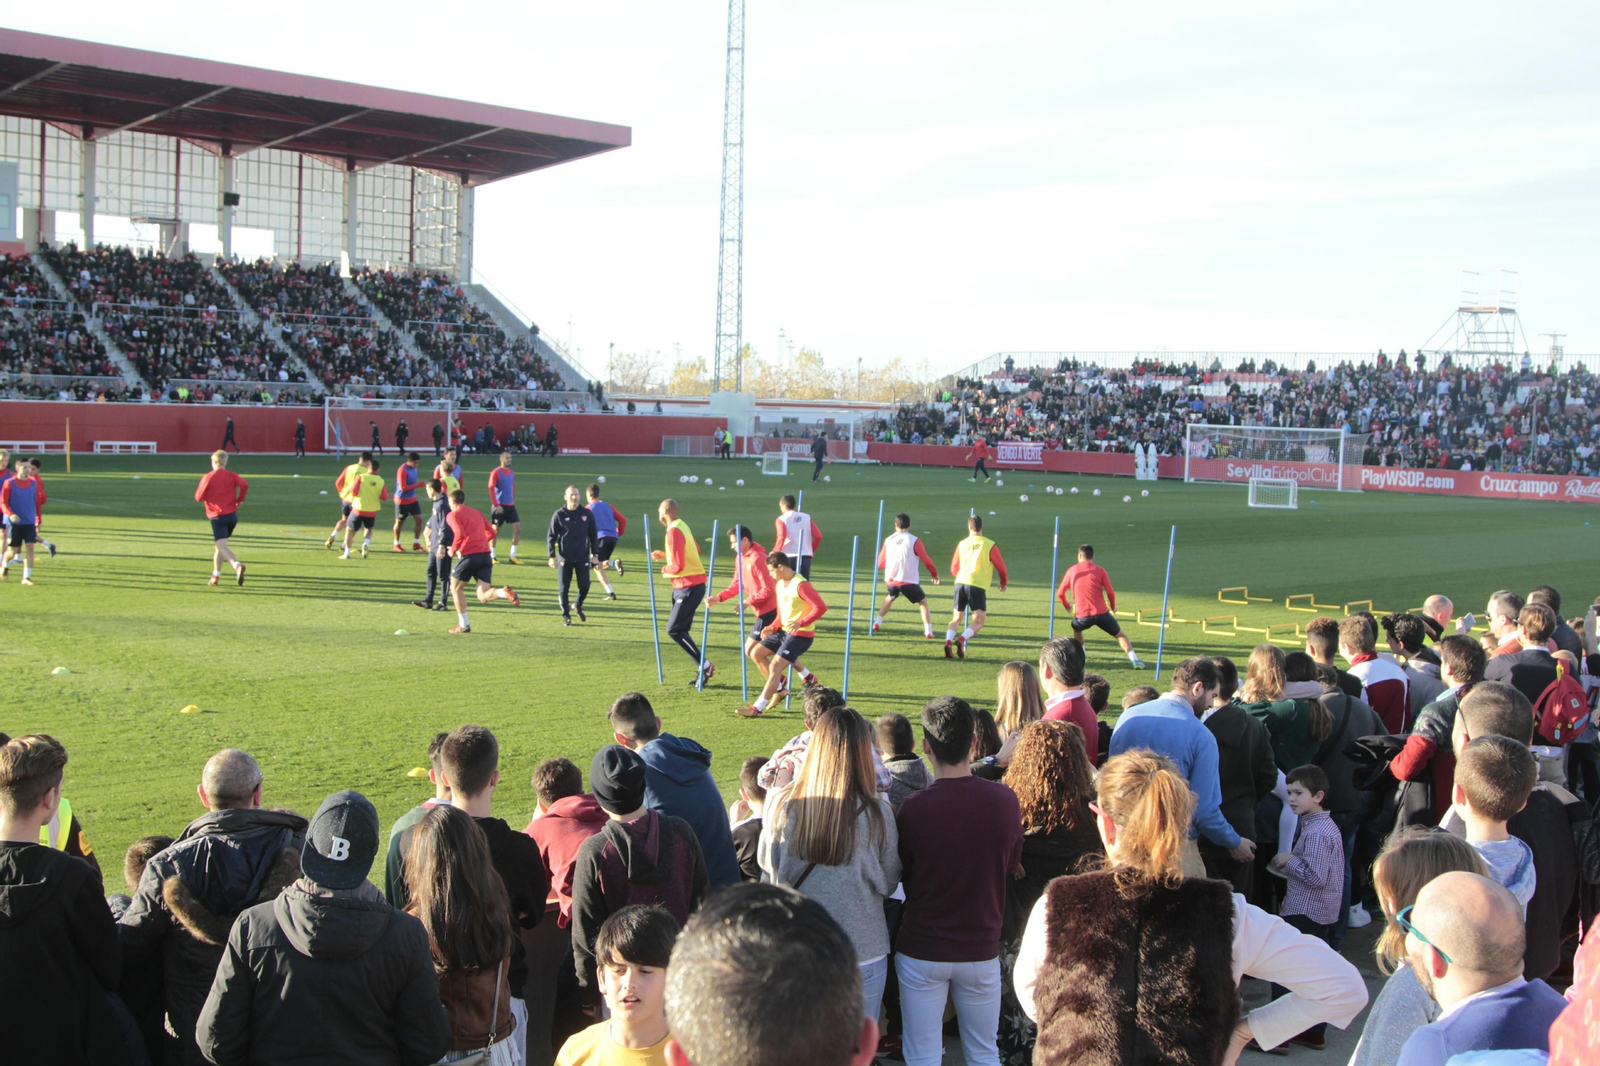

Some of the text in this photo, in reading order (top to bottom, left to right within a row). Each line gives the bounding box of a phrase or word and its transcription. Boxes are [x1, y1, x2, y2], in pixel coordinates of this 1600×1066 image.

[997, 445, 1043, 460] VENGO A VERTE
[1361, 468, 1455, 489] PlayWSOP.com
[1480, 475, 1558, 497] Cruzcampo
[327, 835, 351, 861] B
